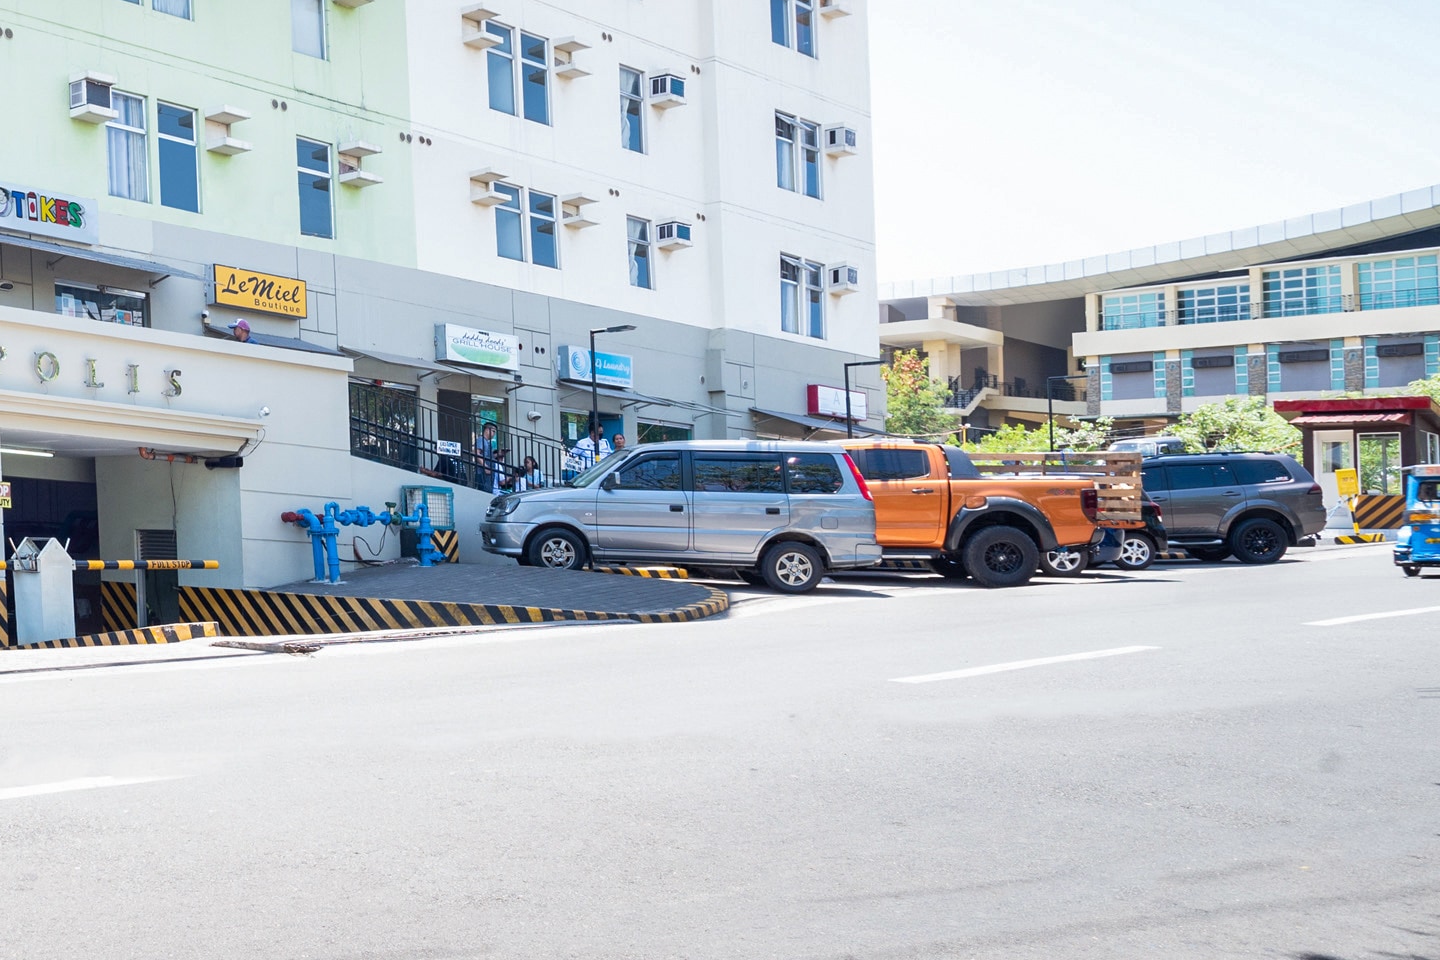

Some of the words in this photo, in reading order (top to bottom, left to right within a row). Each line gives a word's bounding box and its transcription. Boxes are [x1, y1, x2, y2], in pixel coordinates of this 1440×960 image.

[11, 190, 85, 228] TIKES
[254, 298, 301, 314] Boutique
[452, 338, 479, 348] GRILL
[480, 344, 512, 353] HOUSE
